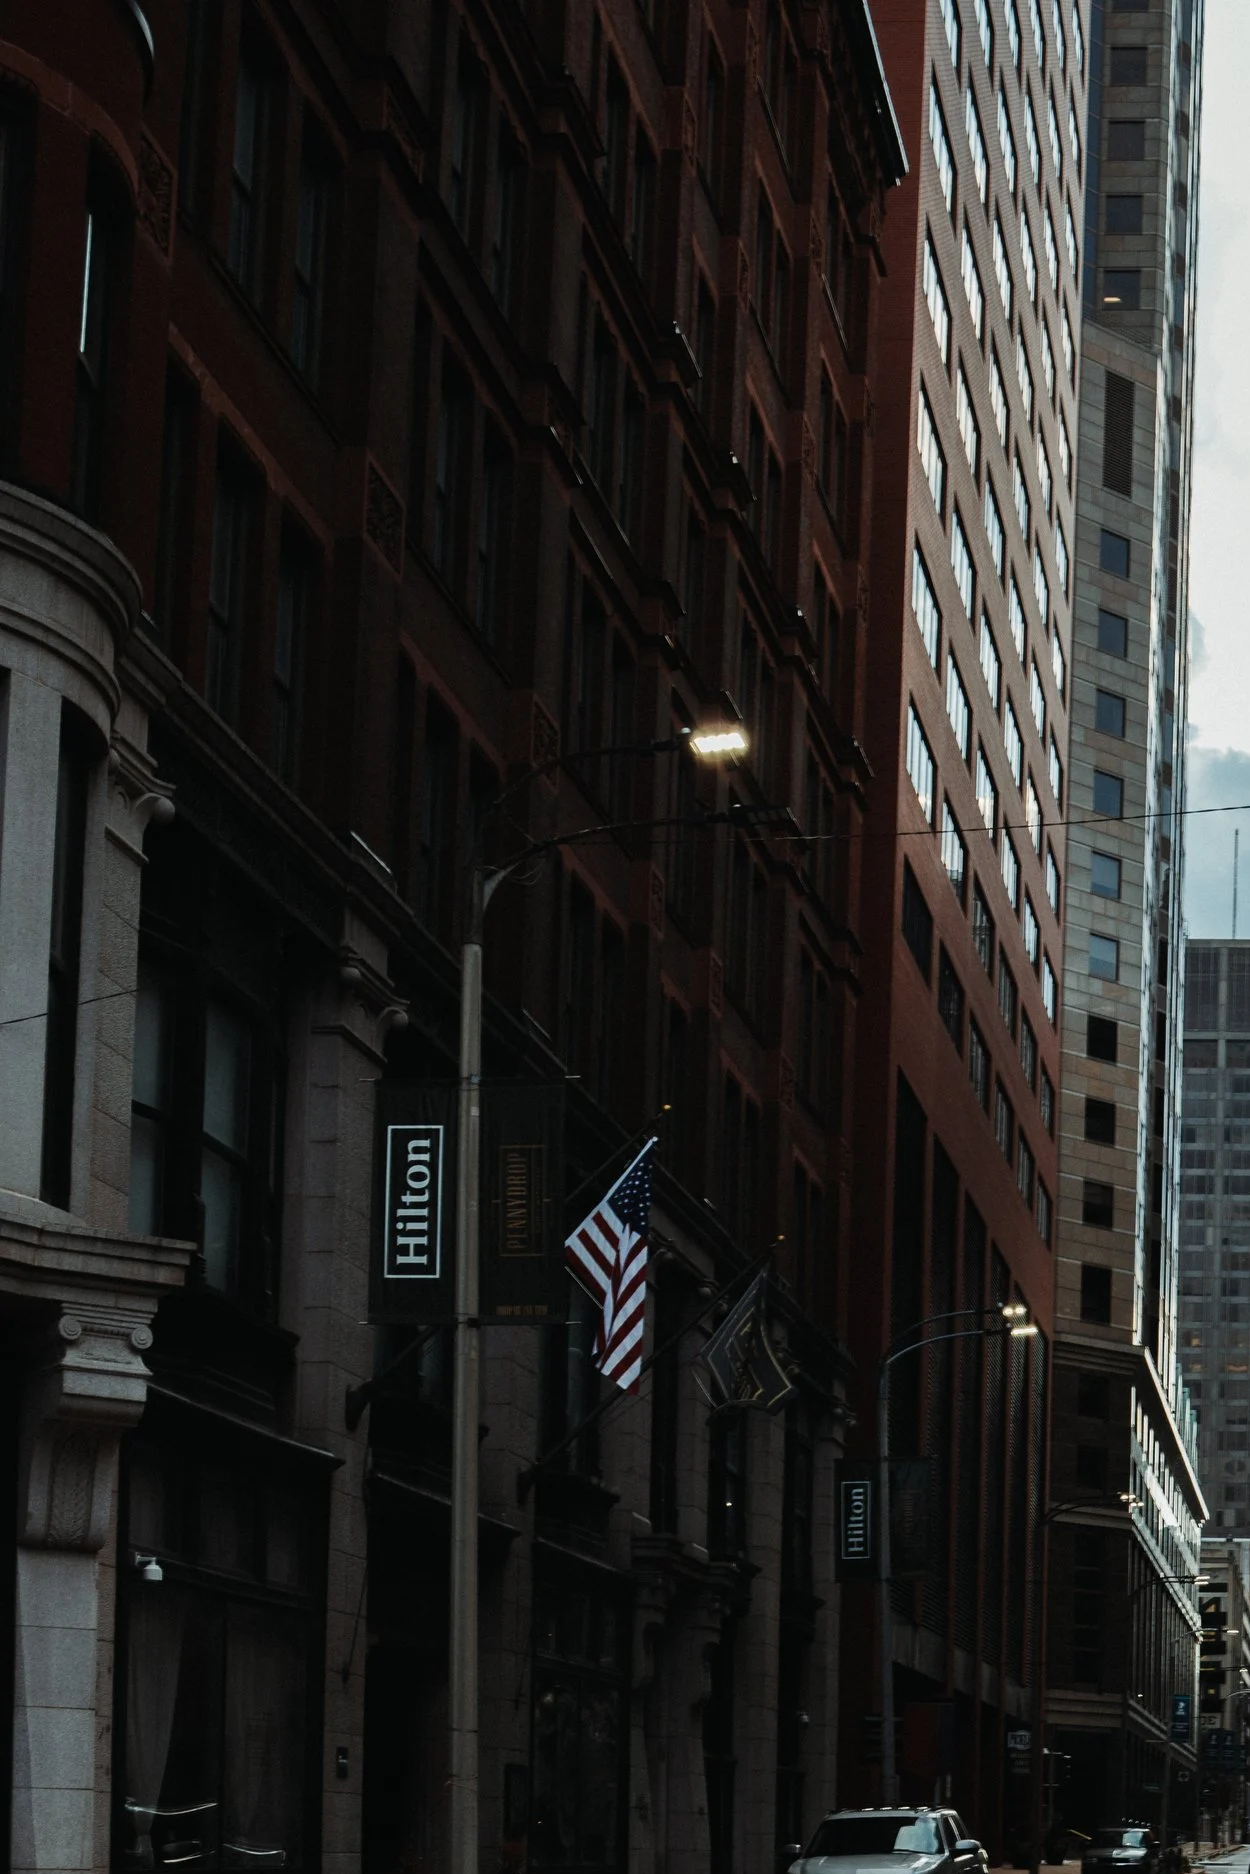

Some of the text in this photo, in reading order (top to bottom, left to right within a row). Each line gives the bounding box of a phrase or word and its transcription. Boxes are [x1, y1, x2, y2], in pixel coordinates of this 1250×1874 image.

[396, 1138, 432, 1266] Hilton
[507, 1153, 527, 1249] PENNYDROP
[847, 1488, 866, 1552] Hilton
